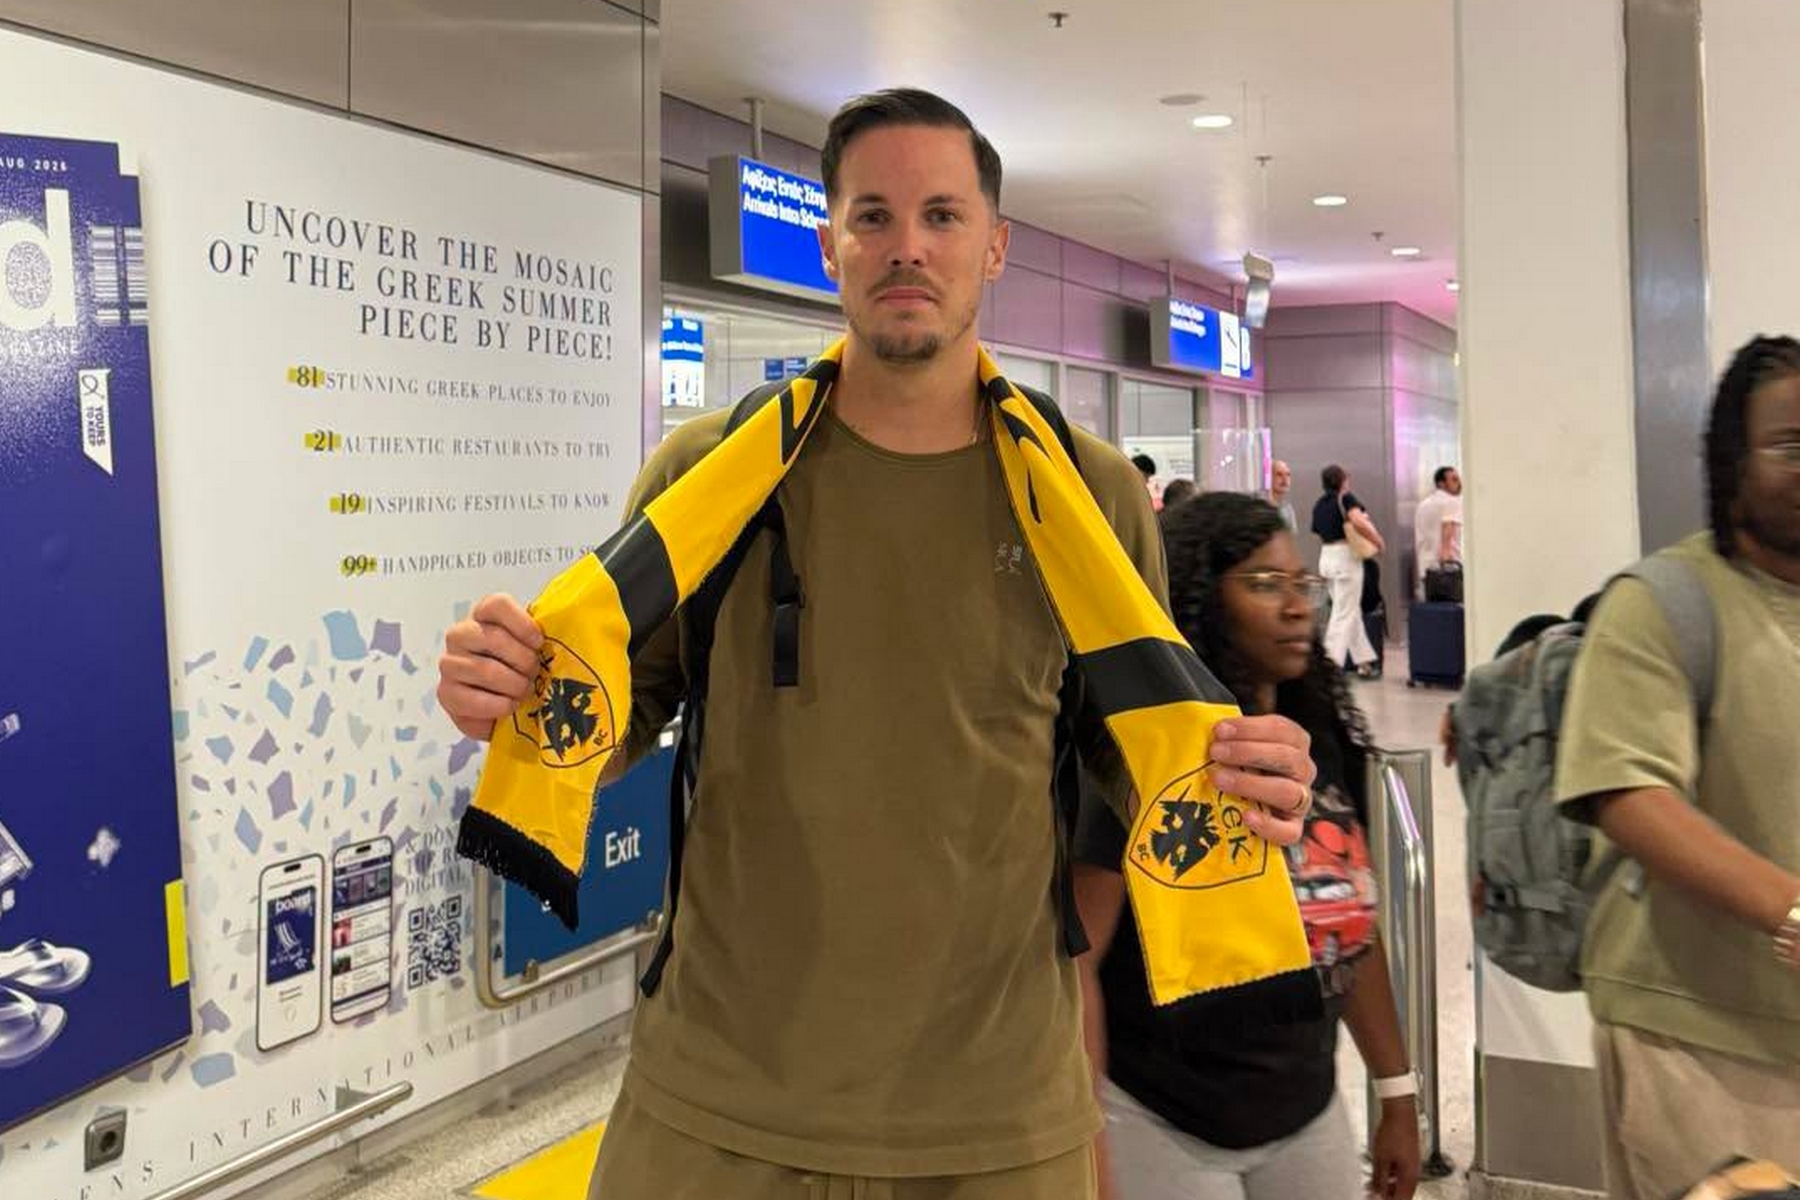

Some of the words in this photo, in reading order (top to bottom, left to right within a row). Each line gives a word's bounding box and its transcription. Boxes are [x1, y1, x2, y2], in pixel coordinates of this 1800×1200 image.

[742, 191, 779, 220] Arrivals
[246, 200, 418, 261] UNCOVER
[438, 236, 498, 274] THE
[515, 251, 612, 294] MOSAIC
[209, 239, 259, 276] OF
[283, 250, 355, 292] THE
[377, 266, 484, 310] GREEK
[502, 285, 611, 327] SUMMER
[360, 304, 458, 345] PIECE
[478, 319, 510, 350] BY
[528, 326, 612, 361] PIECE!
[296, 364, 318, 388] 81
[326, 371, 418, 395] STUNNING
[427, 379, 479, 399] GREEK
[488, 384, 543, 403] PLACES
[549, 388, 567, 404] TO
[572, 389, 611, 408] ENJOY
[95, 405, 106, 447] YOURS
[314, 430, 334, 452] 21
[344, 434, 445, 456] AUTHENTIC
[453, 438, 560, 457] RESTAURANTS
[565, 441, 582, 458] TO
[588, 442, 611, 459] TRY
[340, 492, 361, 515] 19
[366, 495, 457, 515] INSPIRING
[464, 493, 544, 512] FESTIVALS
[551, 493, 568, 510] TO
[574, 491, 610, 509] KNOW
[342, 554, 378, 578] 99+
[382, 551, 487, 575] HANDPICKED
[493, 547, 552, 567] OBJECTS
[558, 546, 574, 562] TO
[605, 826, 641, 868] Exit
[189, 1025, 475, 1162] INTERNATIONAL
